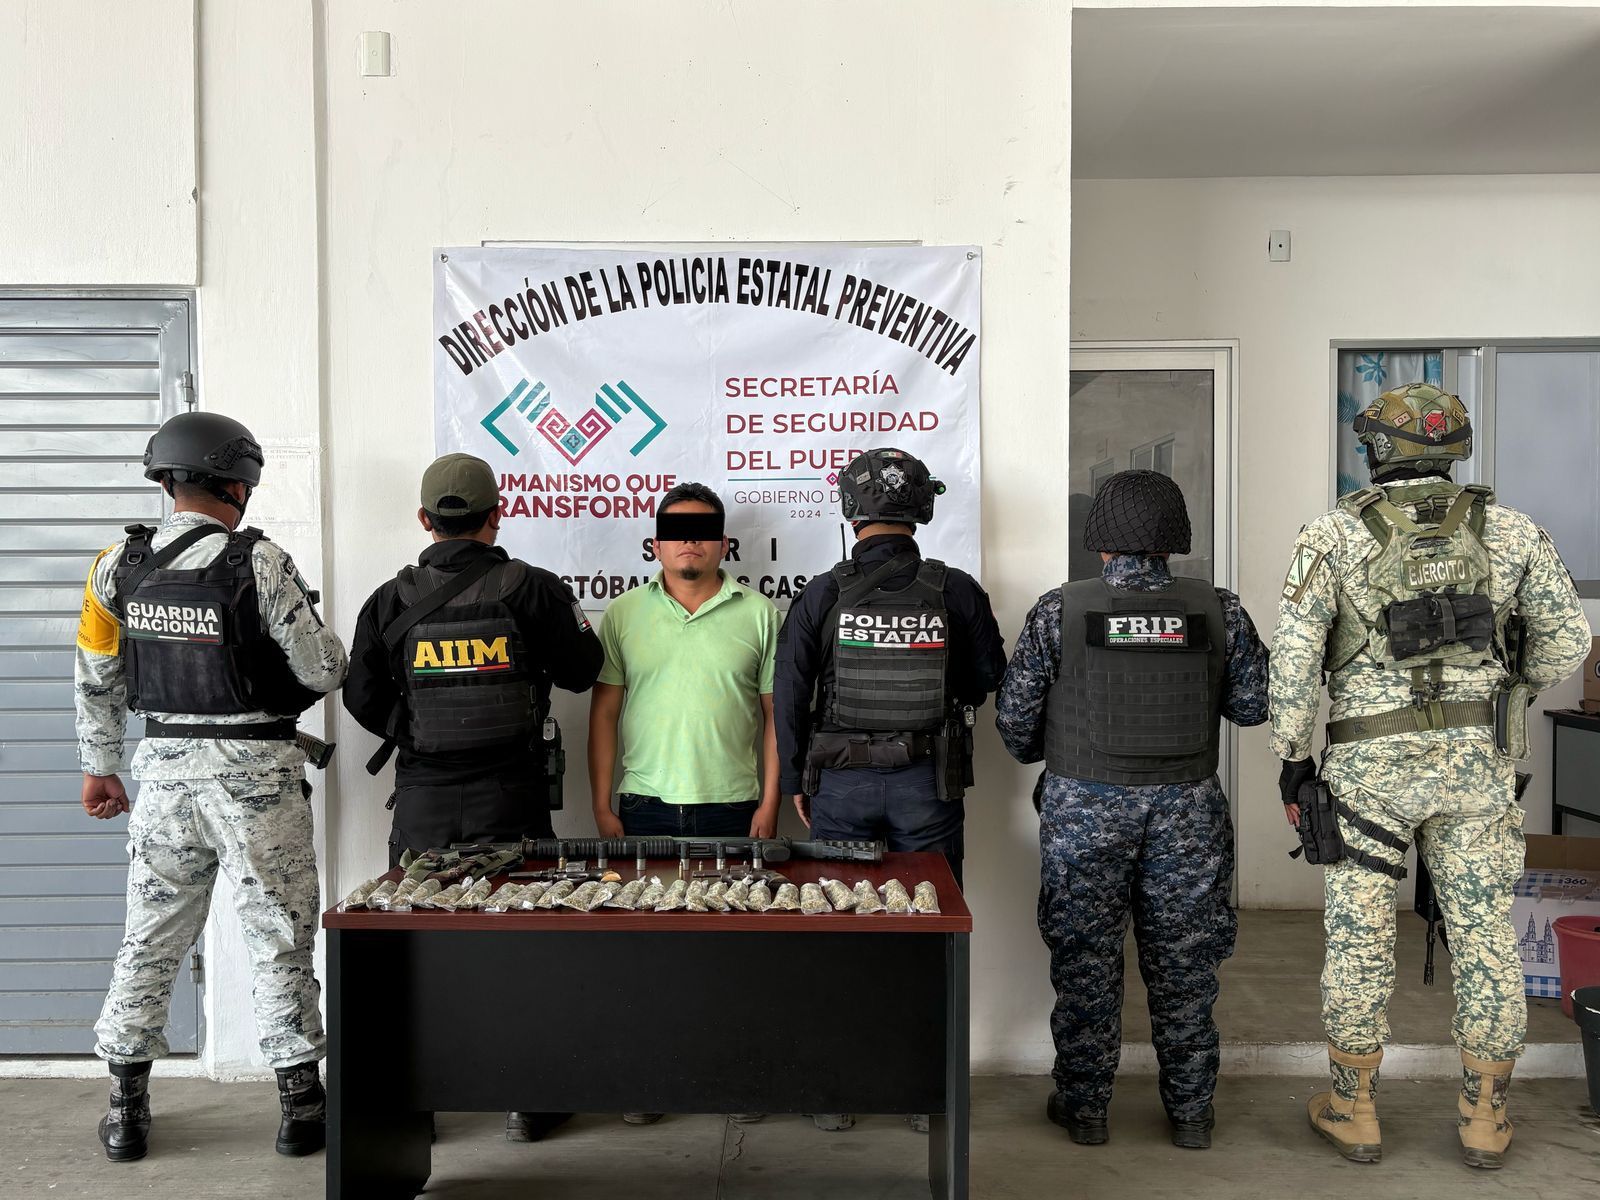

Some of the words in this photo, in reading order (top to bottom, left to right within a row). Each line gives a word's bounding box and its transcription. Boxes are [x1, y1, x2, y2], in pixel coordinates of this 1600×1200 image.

[438, 277, 568, 376] DIRECCIÓN
[564, 270, 603, 322] DE
[600, 264, 637, 314] LA
[636, 257, 730, 308] POLICIA
[737, 257, 832, 316] ESTATAL
[834, 273, 977, 376] PREVENTIVA
[725, 370, 899, 398] SECRETARÍA
[726, 414, 764, 434] DE
[773, 411, 939, 433] SEGURIDAD
[727, 450, 781, 470] DEL
[790, 449, 863, 470] PUE
[498, 473, 621, 492] UMANISMO
[626, 474, 677, 495] QUE
[498, 495, 655, 519] RANSFORM
[734, 490, 824, 504] GOBIERNO
[830, 490, 841, 503] D
[790, 510, 821, 518] 2024
[771, 538, 777, 561] I
[1408, 560, 1466, 586] EJERCITO
[759, 575, 808, 599] CAS
[127, 602, 219, 622] GUARDIA
[840, 613, 945, 628] POLICÍA
[127, 616, 220, 635] NACIONAL
[839, 628, 945, 643] ESTATAL
[1108, 616, 1183, 634] FRIP
[413, 636, 510, 667] AIIM
[1564, 877, 1587, 885] 360
